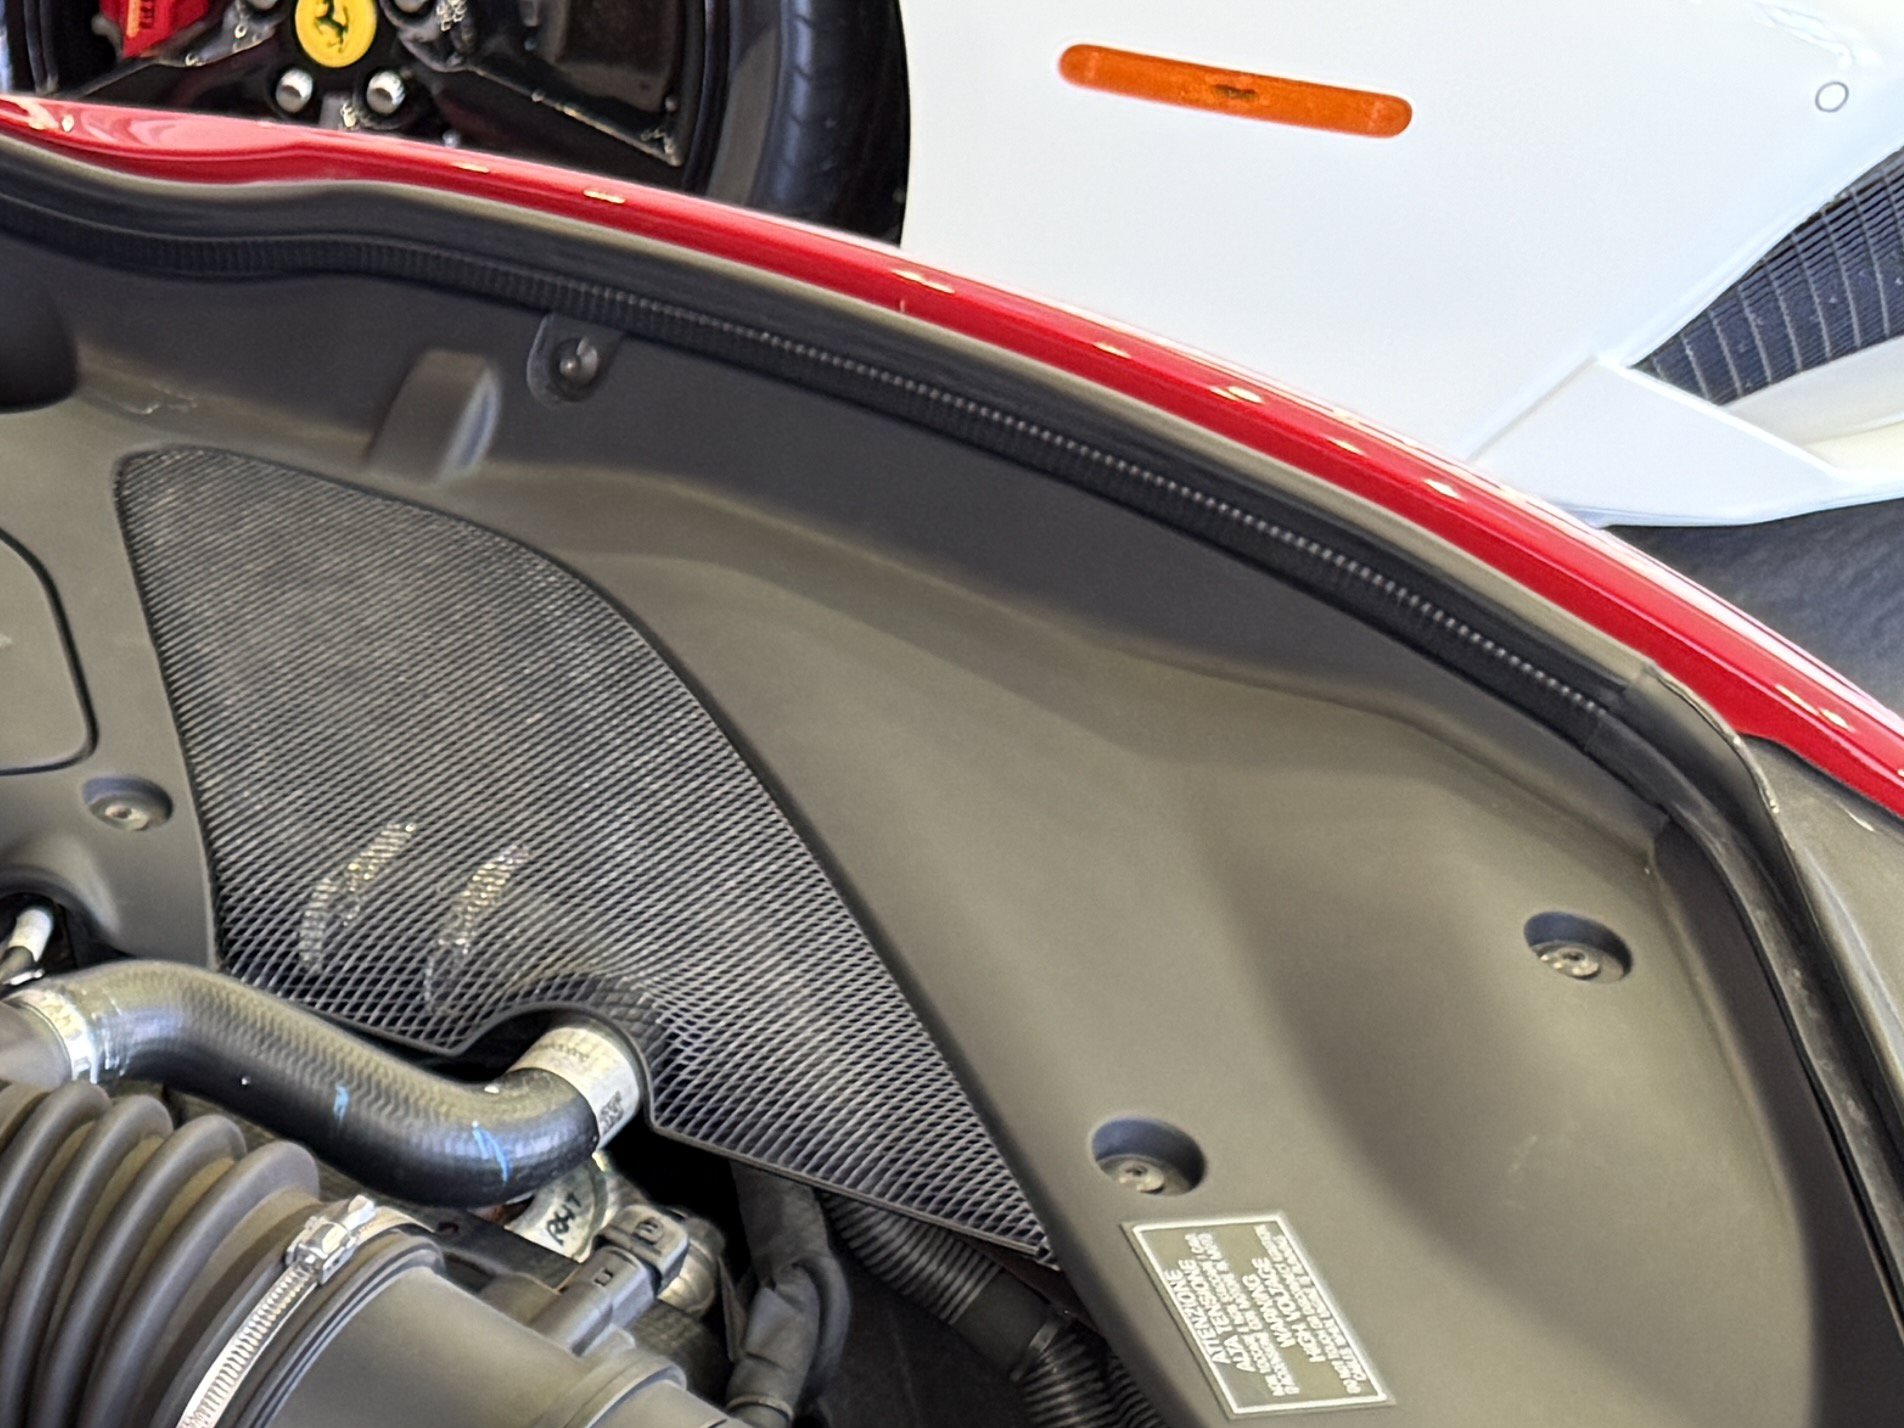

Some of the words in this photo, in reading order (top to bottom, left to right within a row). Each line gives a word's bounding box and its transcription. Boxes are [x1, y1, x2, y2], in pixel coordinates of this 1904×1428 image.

[1164, 1269, 1230, 1363] ATTENZIONE
[1178, 1259, 1232, 1334] TENSIONE
[1242, 1274, 1295, 1347] WARNING
[1251, 1257, 1301, 1321] VOLTAGE
[1223, 1334, 1256, 1372] ALTA
[1291, 1323, 1326, 1362] HIGH
